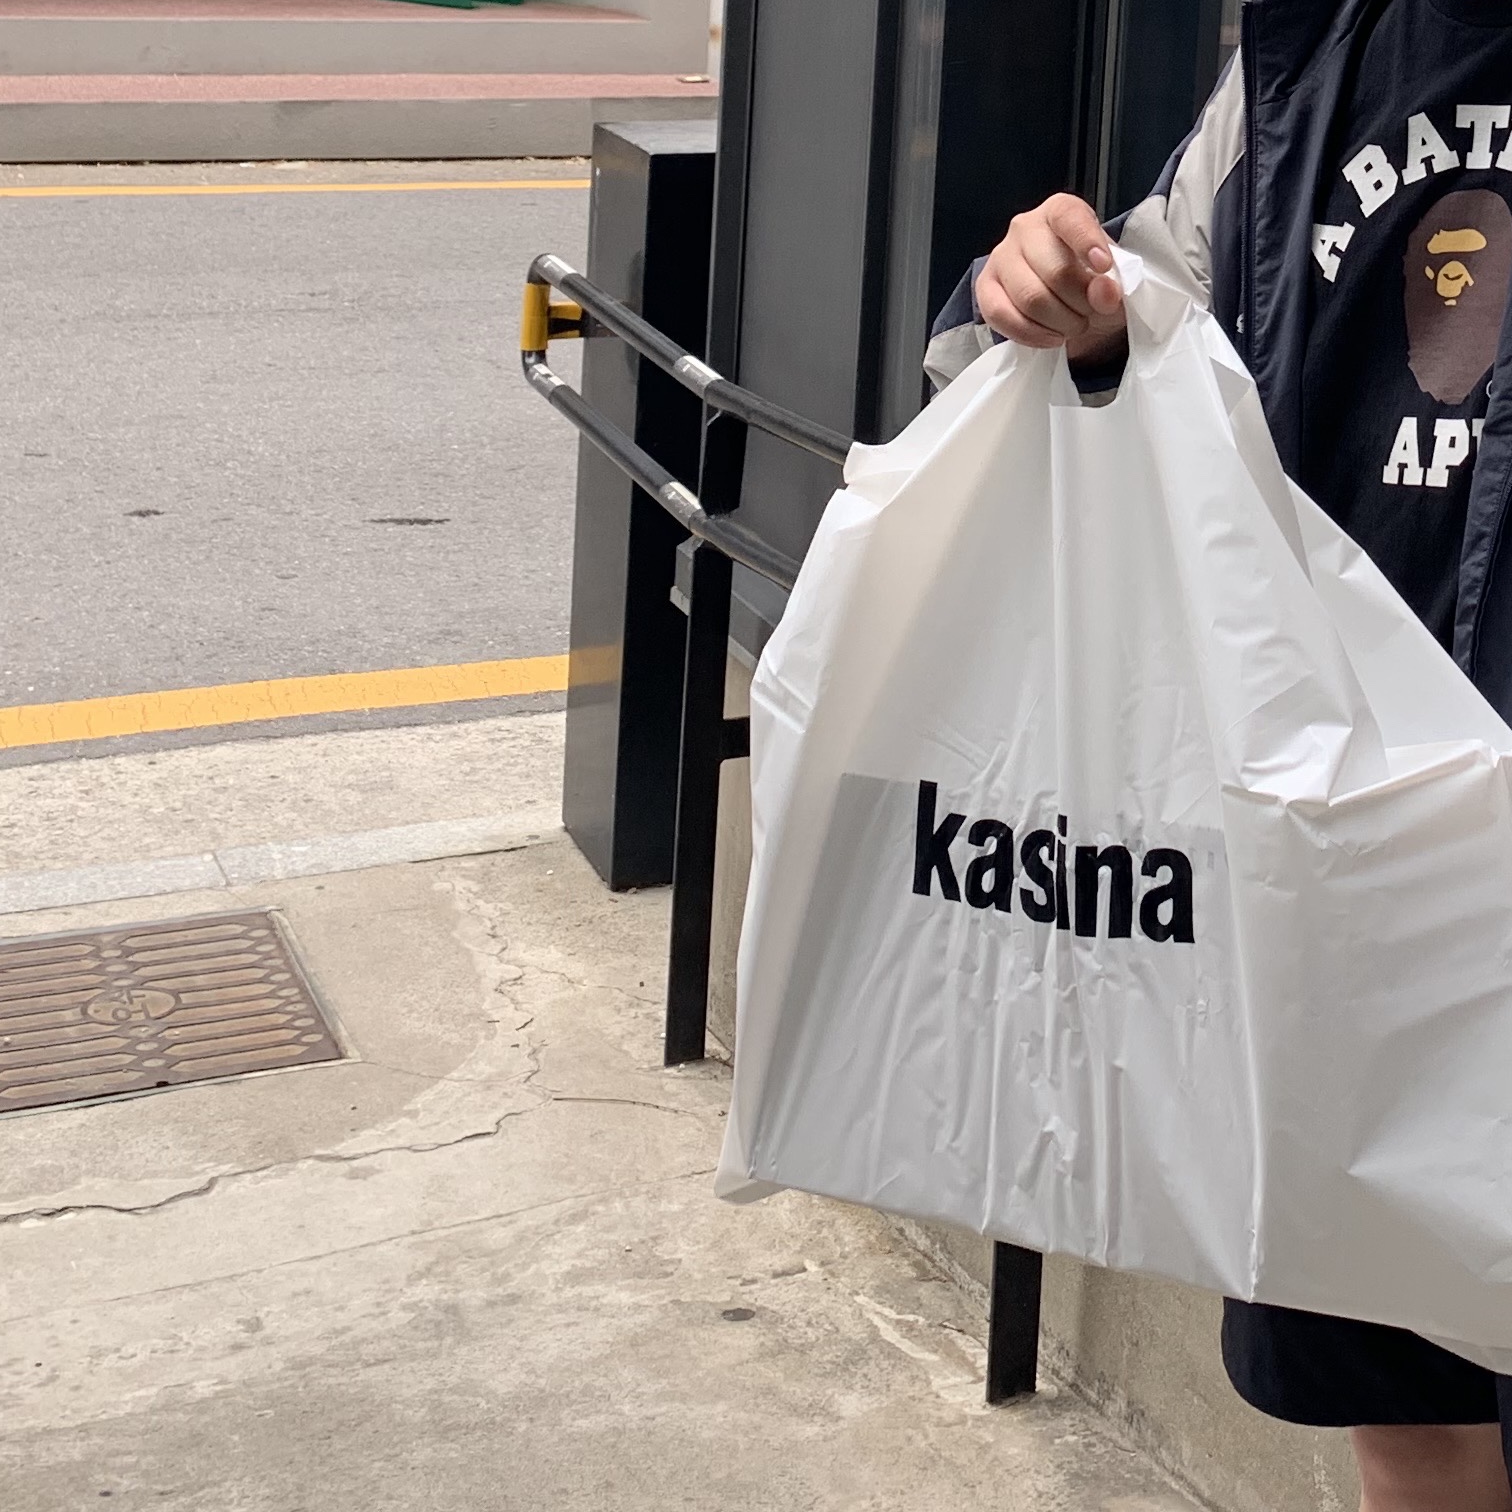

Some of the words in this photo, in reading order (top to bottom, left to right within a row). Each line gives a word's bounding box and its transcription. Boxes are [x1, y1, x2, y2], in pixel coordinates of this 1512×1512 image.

[1311, 221, 1356, 283] A
[1381, 416, 1486, 488] AP
[912, 779, 1196, 945] kasina
